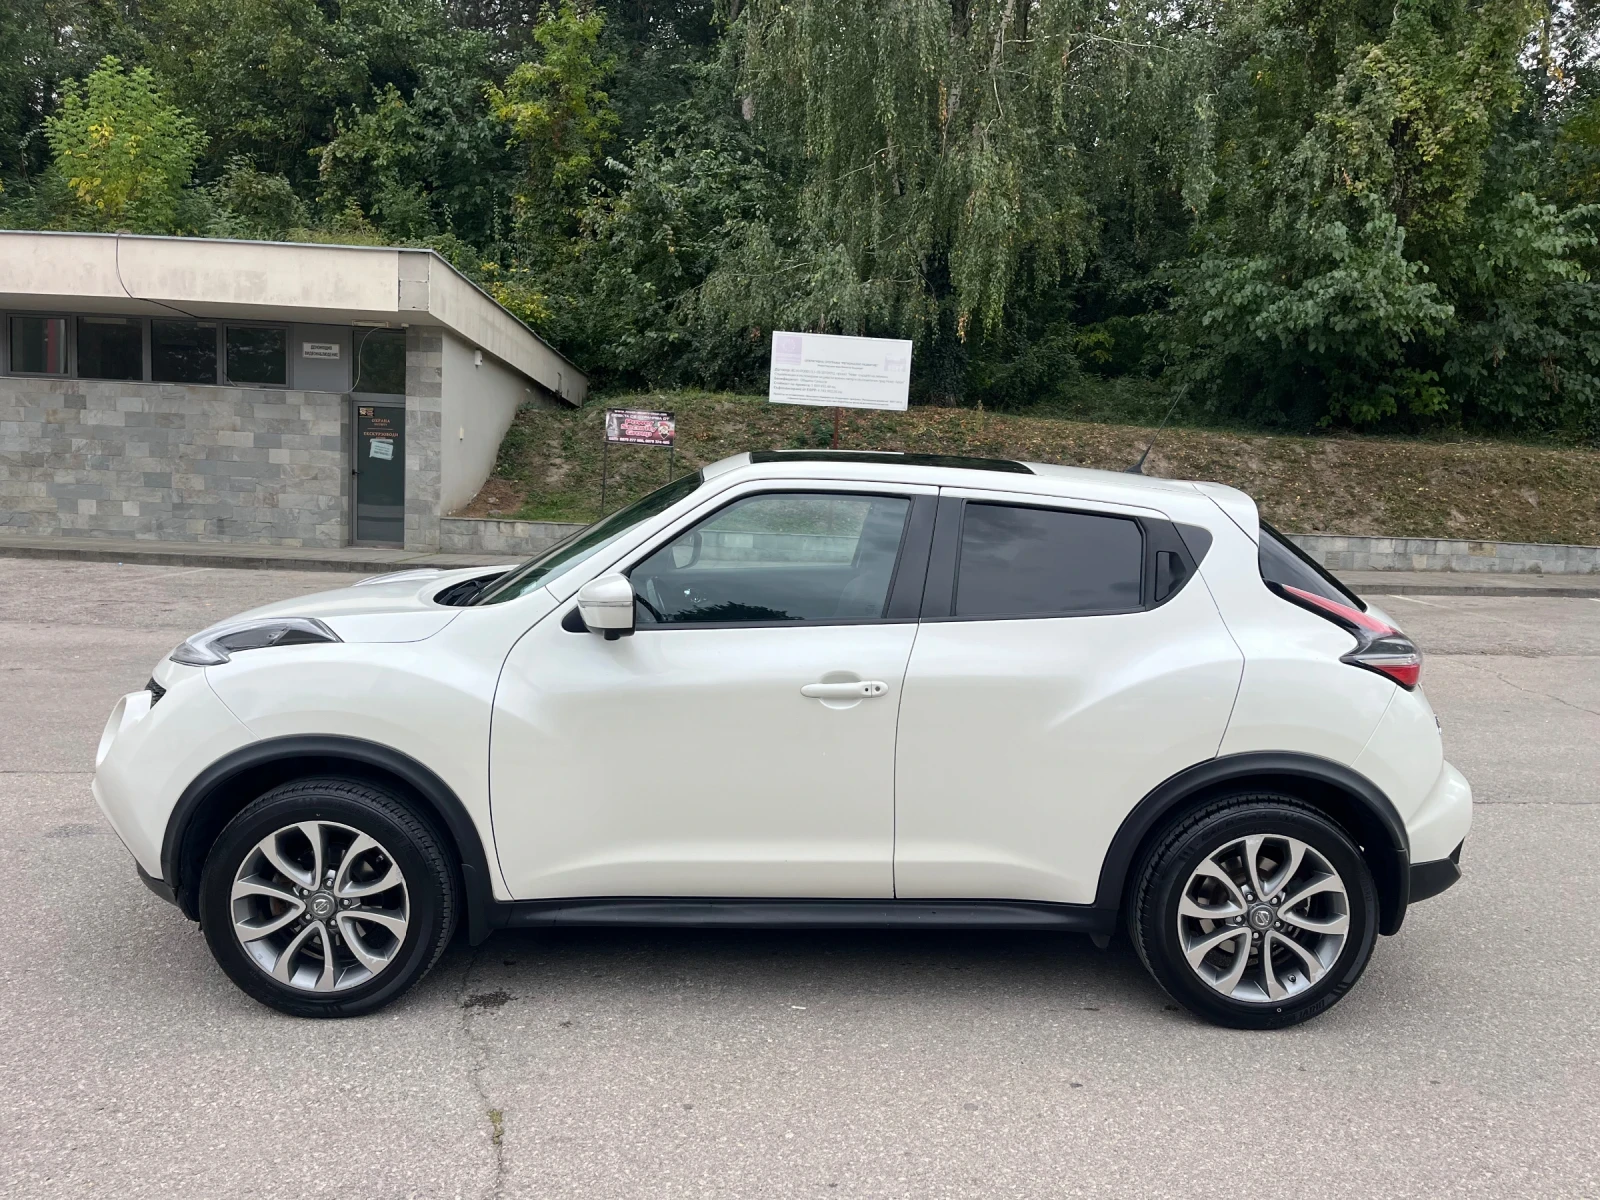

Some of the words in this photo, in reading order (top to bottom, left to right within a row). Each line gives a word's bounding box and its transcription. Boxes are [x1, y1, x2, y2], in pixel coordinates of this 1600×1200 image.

[625, 418, 654, 426] Power
[621, 423, 658, 433] Security
[625, 430, 653, 438] Group
